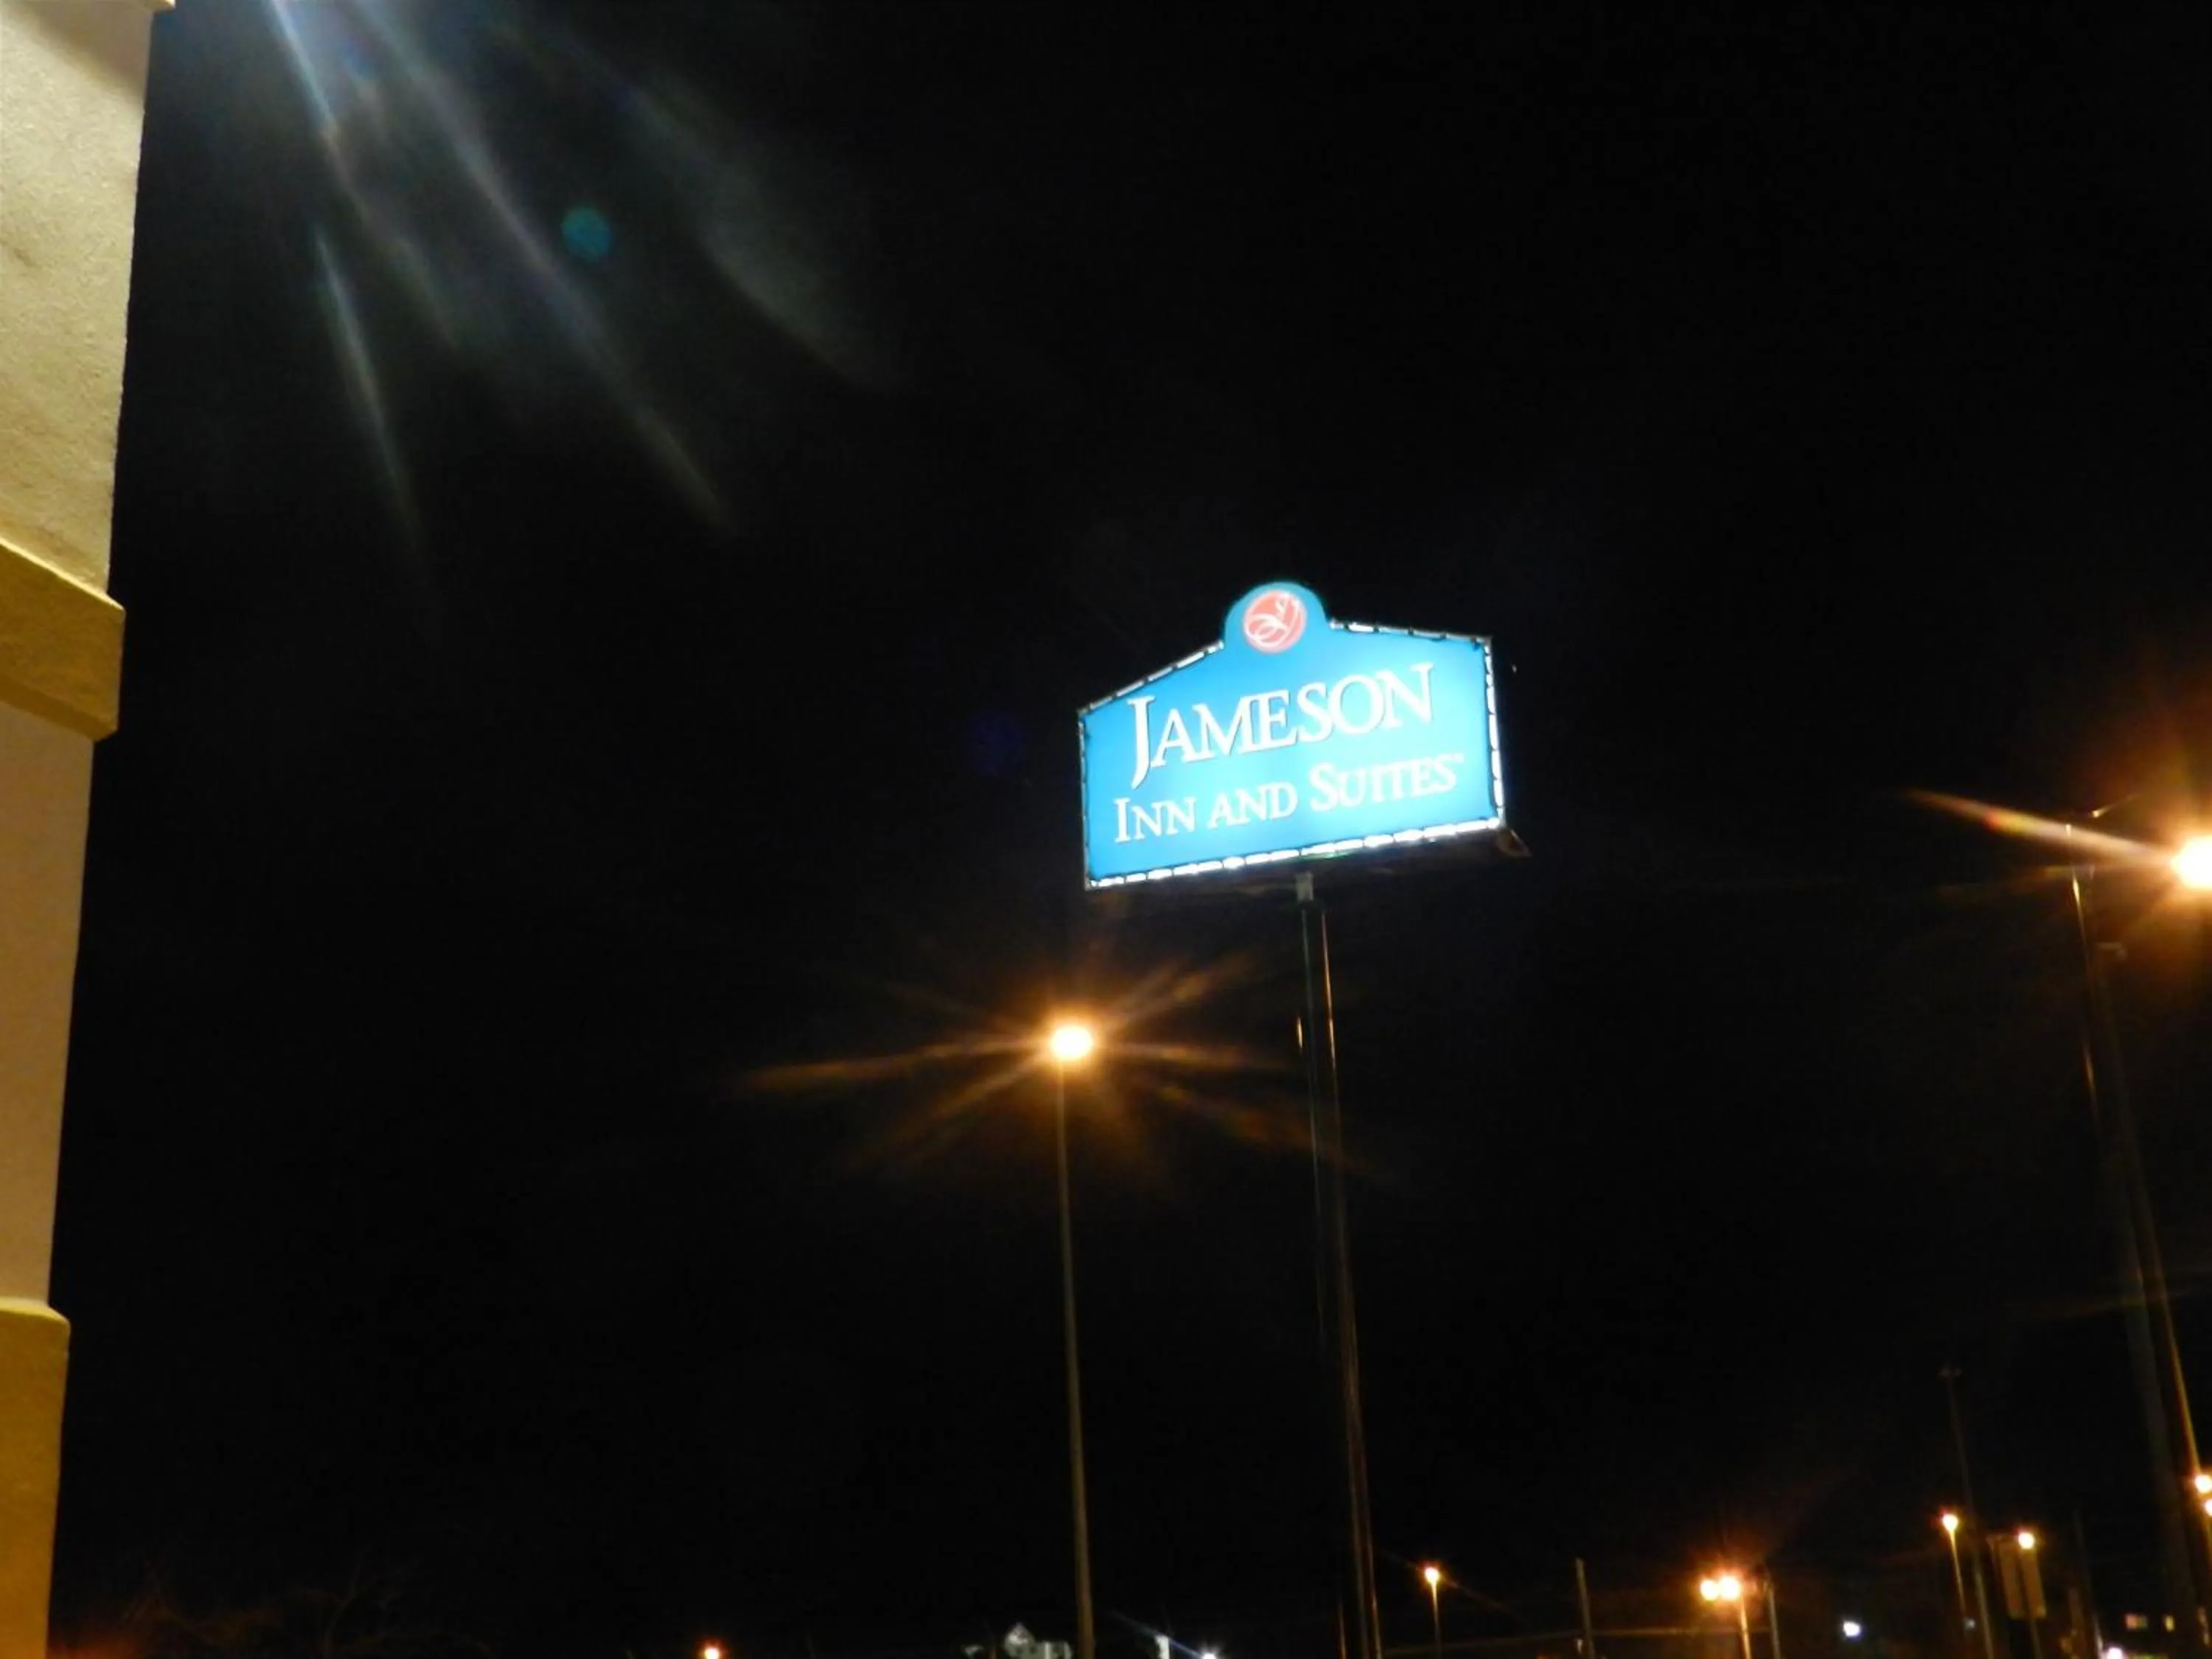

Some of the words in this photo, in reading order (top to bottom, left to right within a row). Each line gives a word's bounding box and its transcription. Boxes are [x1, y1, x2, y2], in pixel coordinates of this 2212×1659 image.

[1127, 663, 1435, 789] JAMESON
[1115, 797, 1196, 843] INN
[1209, 781, 1298, 830] AND
[1309, 754, 1458, 812] SUITES
